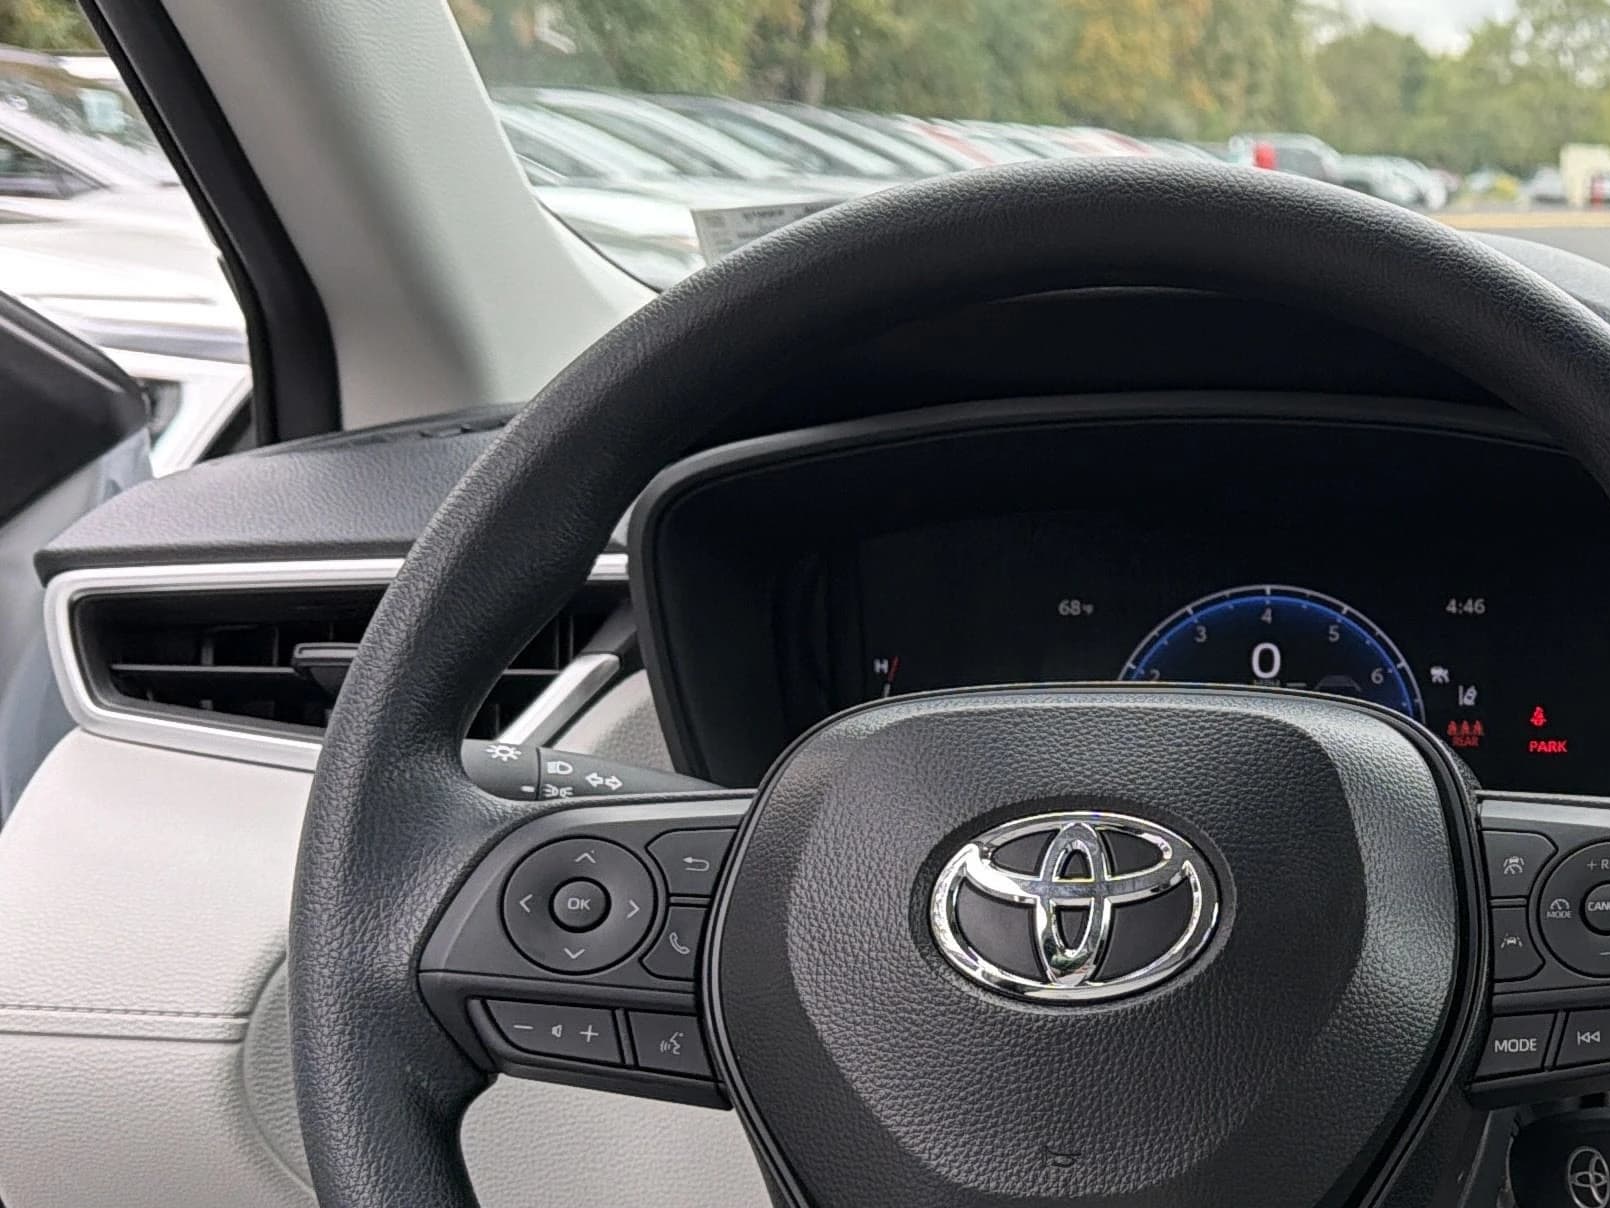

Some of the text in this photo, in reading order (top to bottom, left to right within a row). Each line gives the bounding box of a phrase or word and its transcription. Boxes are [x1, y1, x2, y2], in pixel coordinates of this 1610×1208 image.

[1445, 598, 1486, 615] 4:46
[1260, 608, 1273, 624] 4
[1195, 626, 1207, 643] 3
[1328, 625, 1340, 642] 5
[873, 658, 889, 674] H
[1251, 642, 1282, 680] 0
[1371, 667, 1385, 685] 6
[1528, 740, 1568, 753] PARK
[568, 897, 591, 911] OK
[1546, 910, 1572, 919] MODE
[1494, 1038, 1537, 1053] MODE
